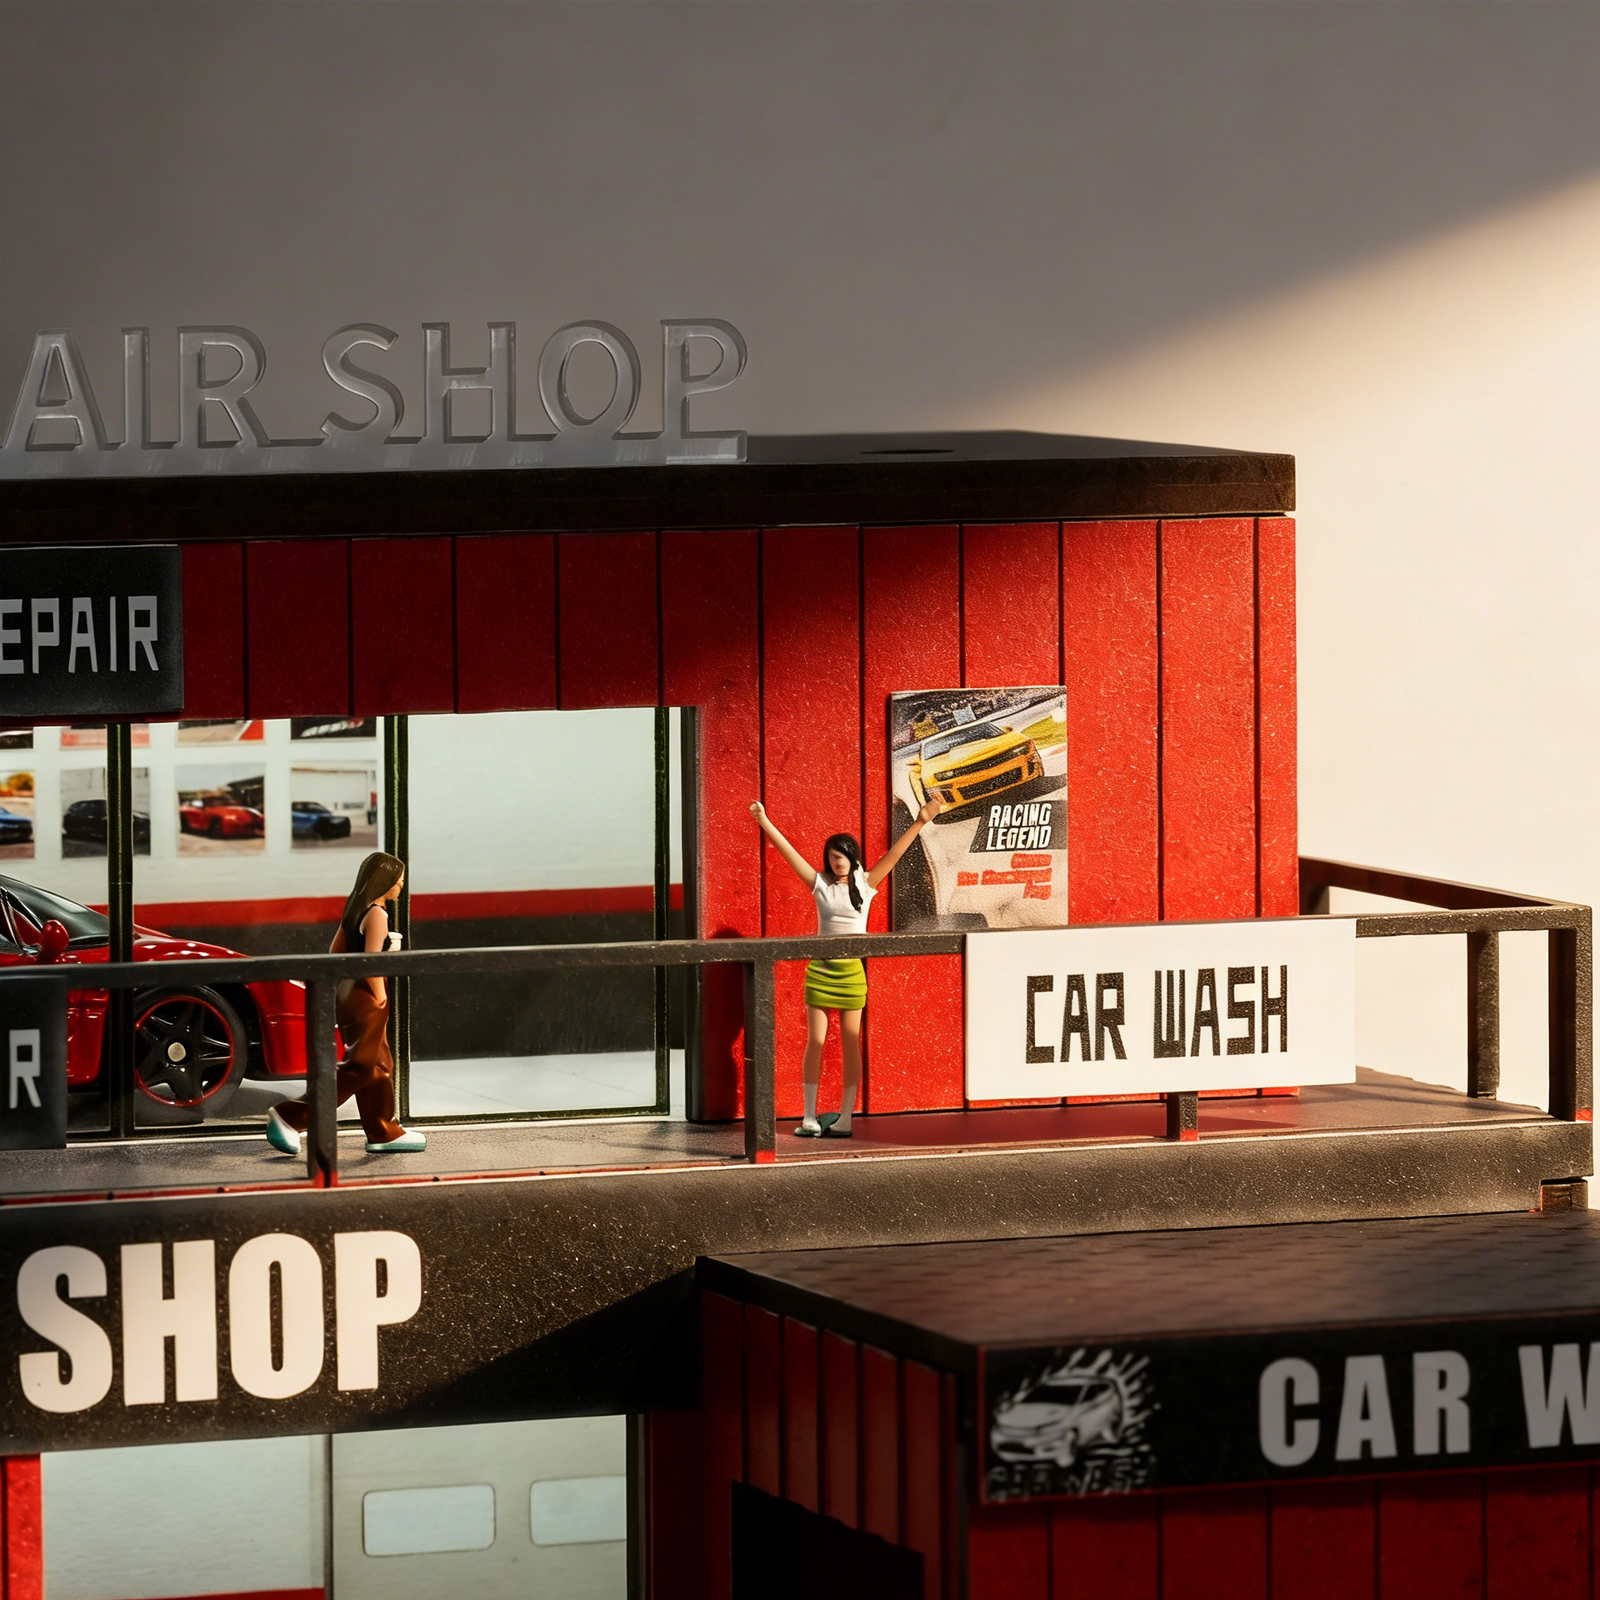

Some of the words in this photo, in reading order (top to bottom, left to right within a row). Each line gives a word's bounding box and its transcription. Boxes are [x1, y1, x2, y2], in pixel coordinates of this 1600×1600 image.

[3, 325, 269, 451] AIR
[320, 318, 748, 447] SHOP
[0, 595, 160, 675] EPAIR
[985, 825, 1052, 851] LEGEND
[987, 803, 1053, 828] RACING
[1025, 972, 1128, 1064] CAR
[1153, 965, 1288, 1060] WASH
[9, 1029, 42, 1110] R
[16, 1230, 423, 1414] SHOP
[1258, 1350, 1471, 1468] CAR
[1518, 1341, 1600, 1449] W
